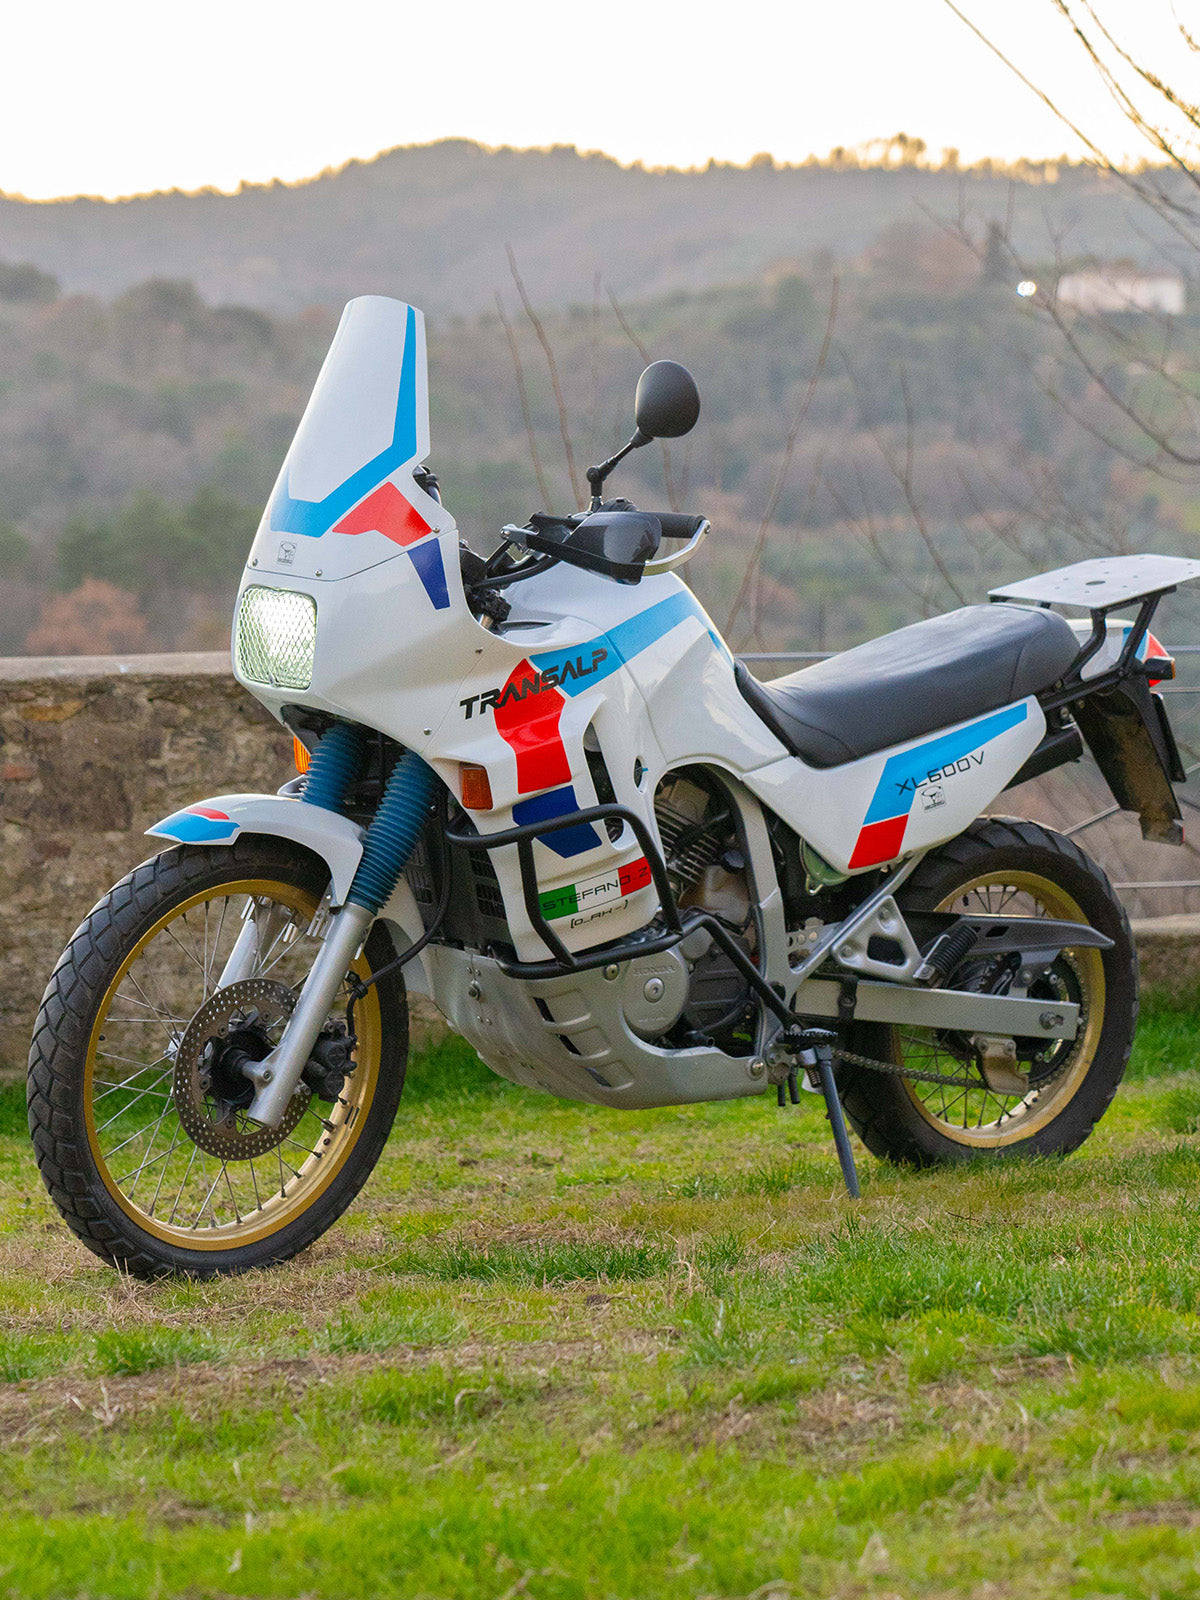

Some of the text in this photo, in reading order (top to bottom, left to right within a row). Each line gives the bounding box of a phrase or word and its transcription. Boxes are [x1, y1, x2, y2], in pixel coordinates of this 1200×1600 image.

[459, 647, 608, 720] TRANSALP
[895, 750, 985, 796] XL600V
[542, 874, 631, 911] STEFANO
